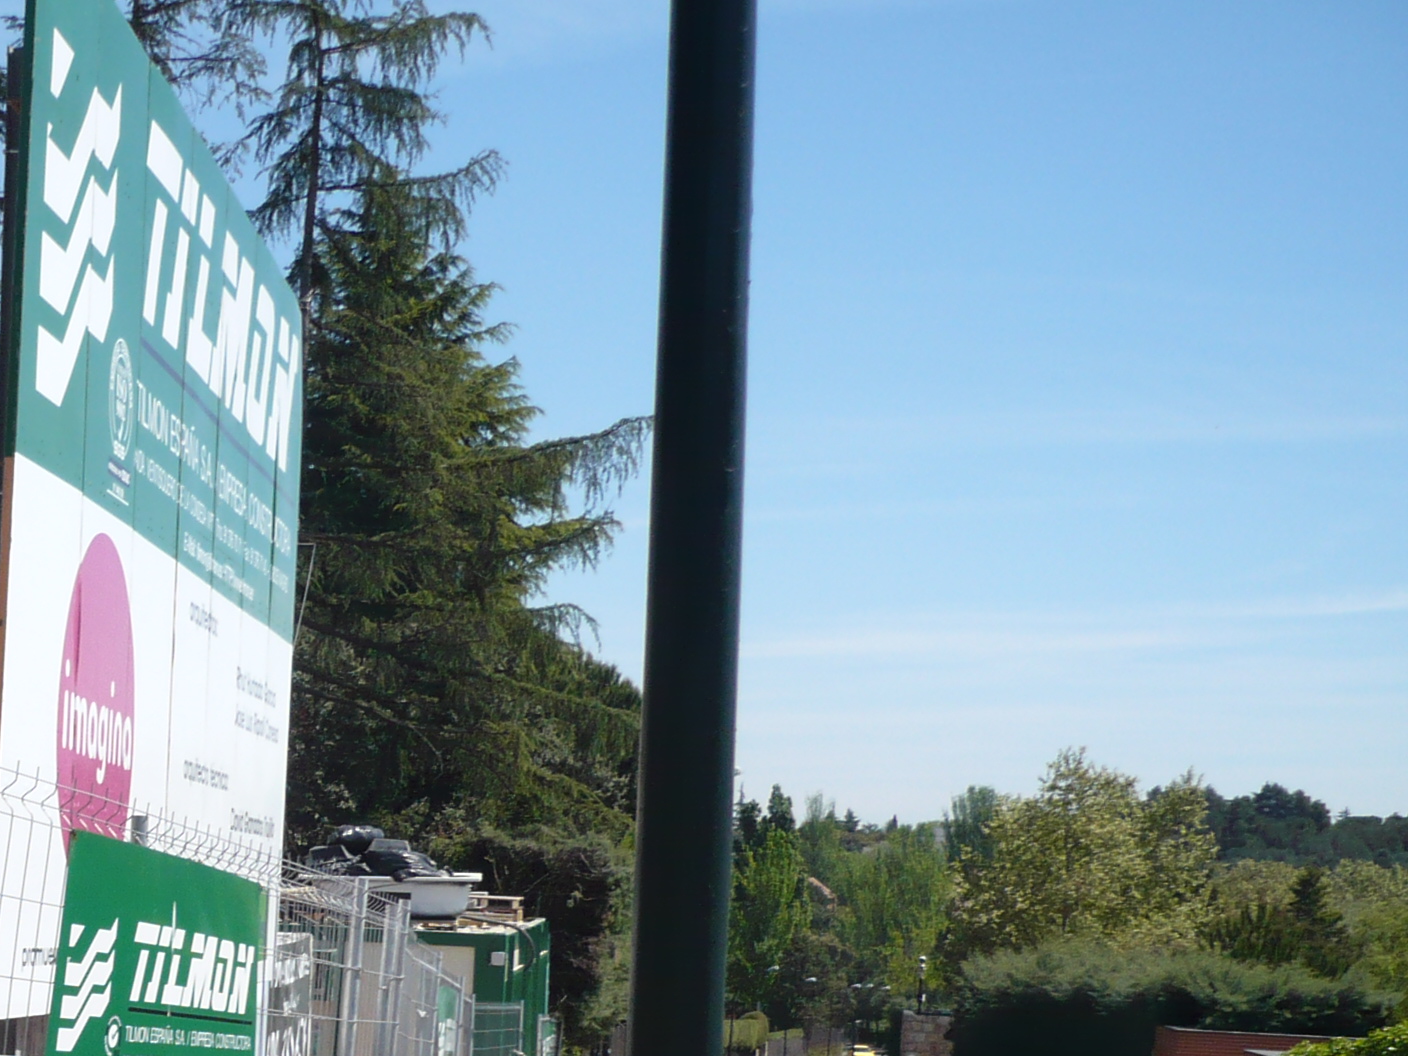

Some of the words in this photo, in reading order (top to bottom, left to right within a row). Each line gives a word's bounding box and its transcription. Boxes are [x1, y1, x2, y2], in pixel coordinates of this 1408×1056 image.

[143, 119, 300, 473] TILMON
[136, 379, 169, 446] TILMON
[170, 414, 200, 475] ESPAÑA
[61, 659, 132, 785] imagina
[129, 921, 255, 1014] TILMON
[125, 1025, 150, 1043] TILMON
